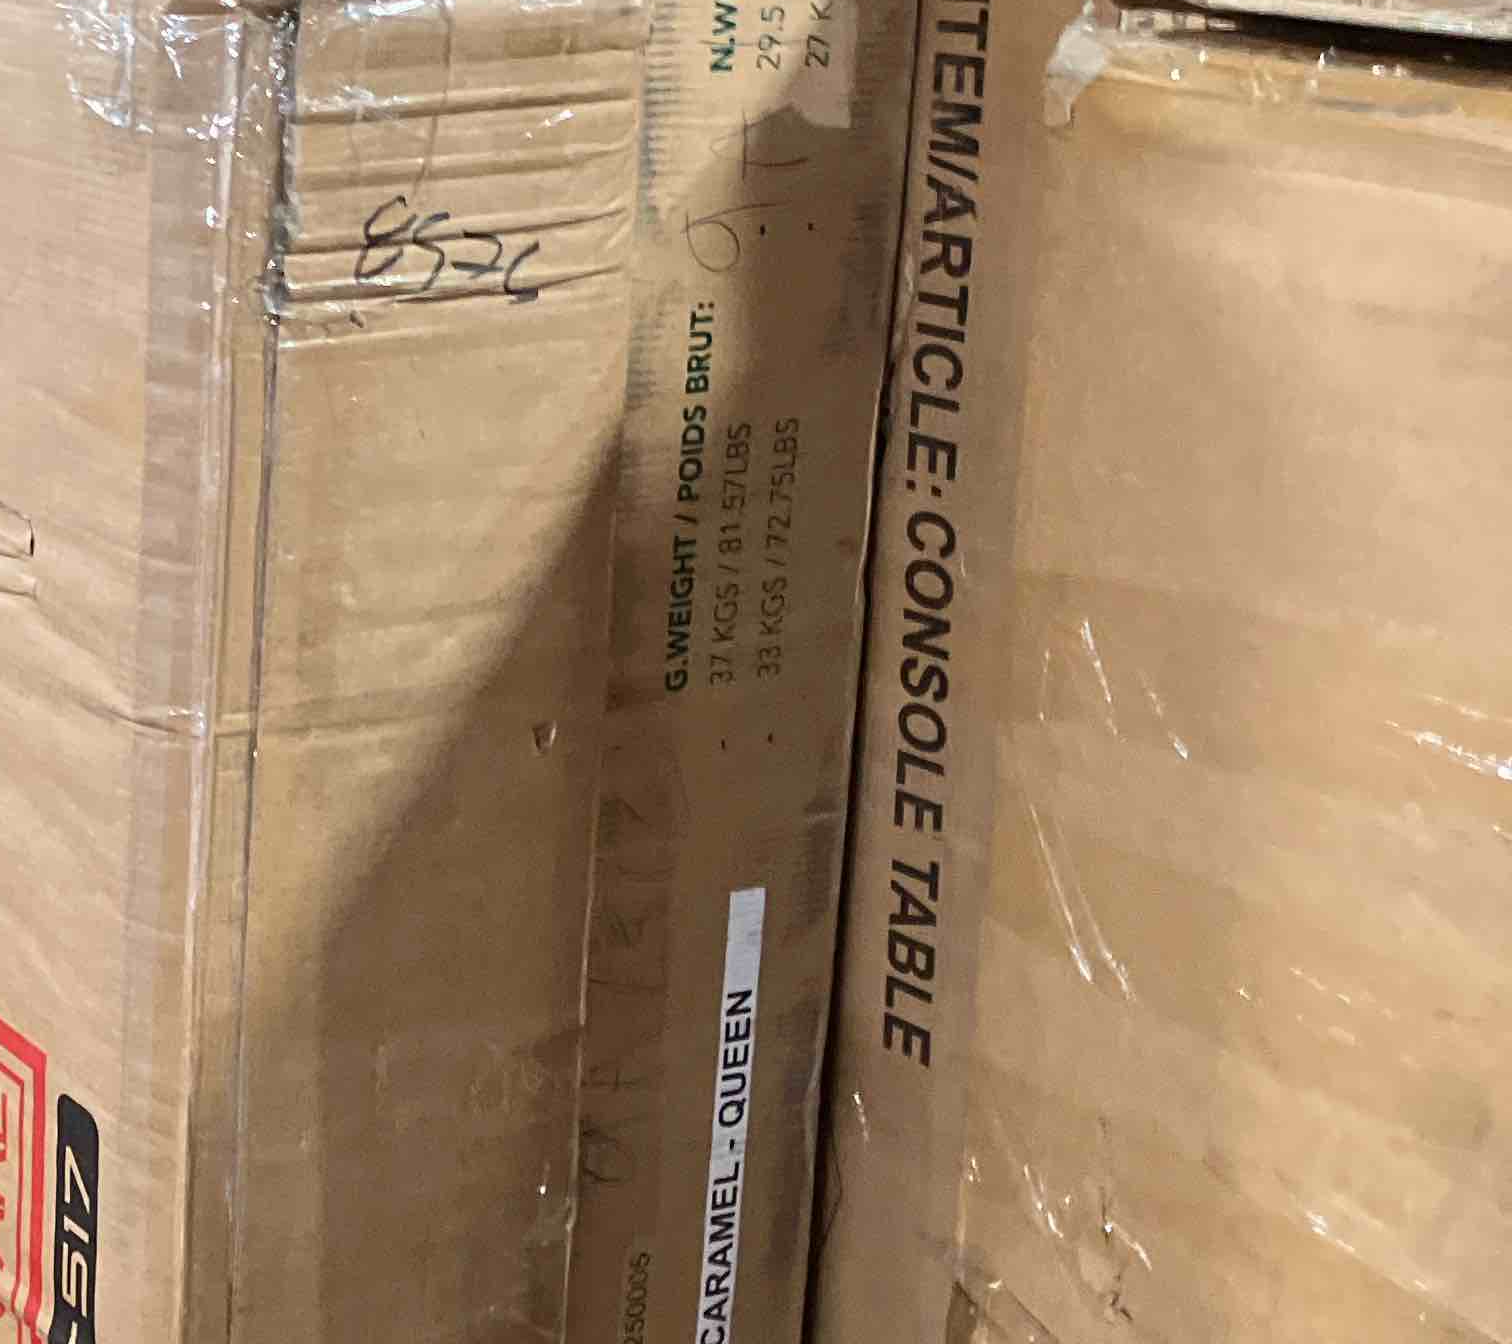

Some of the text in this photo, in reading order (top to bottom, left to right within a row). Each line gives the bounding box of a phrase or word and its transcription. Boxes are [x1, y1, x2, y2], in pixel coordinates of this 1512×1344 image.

[755, 6, 786, 71] 29.5
[804, 34, 831, 67] 27
[684, 301, 715, 395] BRUT:
[677, 406, 707, 503] POIDS
[665, 535, 697, 693] G.WEIGHT
[712, 583, 740, 643] KGS
[761, 576, 788, 635] KGS
[709, 657, 735, 685] 37
[757, 647, 782, 676] 33
[893, 509, 958, 832] CONSOLE
[881, 858, 940, 1065] TABLE
[718, 988, 752, 1129] QUEEN
